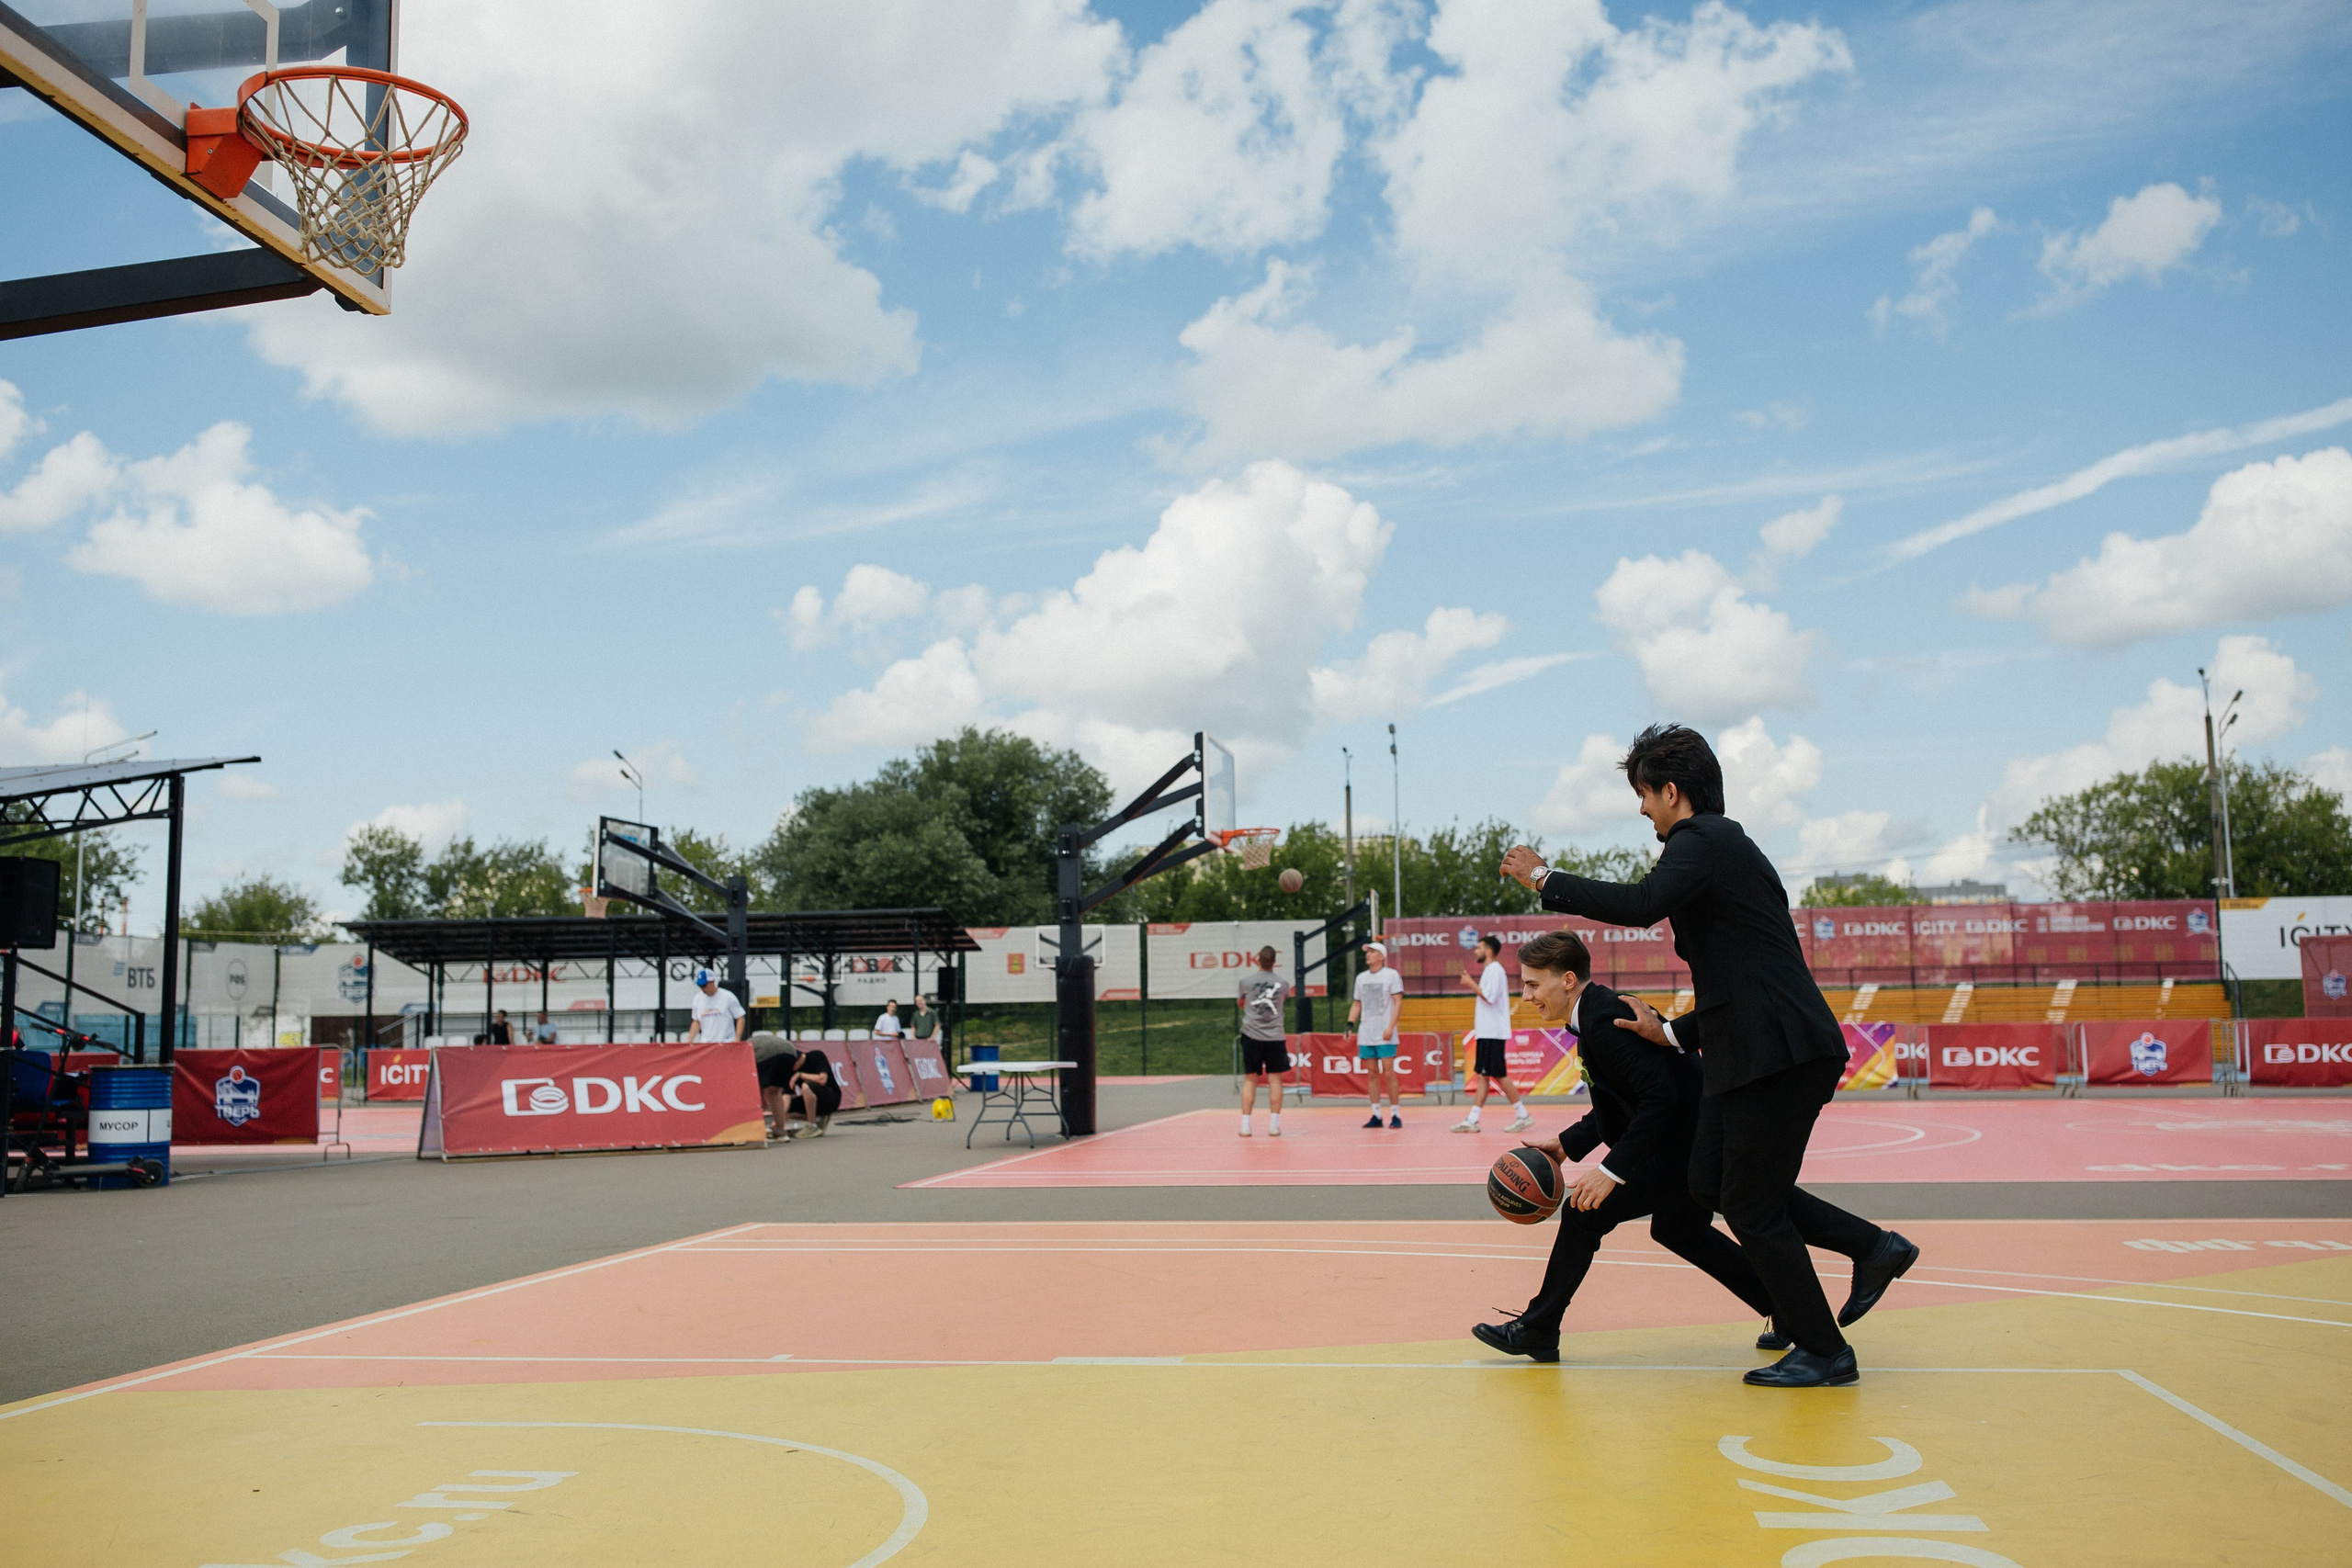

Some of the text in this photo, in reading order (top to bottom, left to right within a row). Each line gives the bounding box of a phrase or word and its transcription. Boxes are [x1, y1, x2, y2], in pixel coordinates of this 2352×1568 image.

[1864, 921, 1907, 936] DKC
[1912, 920, 1958, 936] ICITY
[1986, 919, 2029, 933] DKC
[2134, 915, 2177, 931] DKC
[1410, 932, 1450, 946] DKC
[1623, 928, 1665, 942] DKC
[127, 966, 155, 988] ВТБ
[1974, 1046, 2040, 1066] DKC
[572, 1074, 707, 1115] DKC
[214, 1104, 260, 1119] ТВЕРЬ
[98, 1121, 139, 1132] МУСОР
